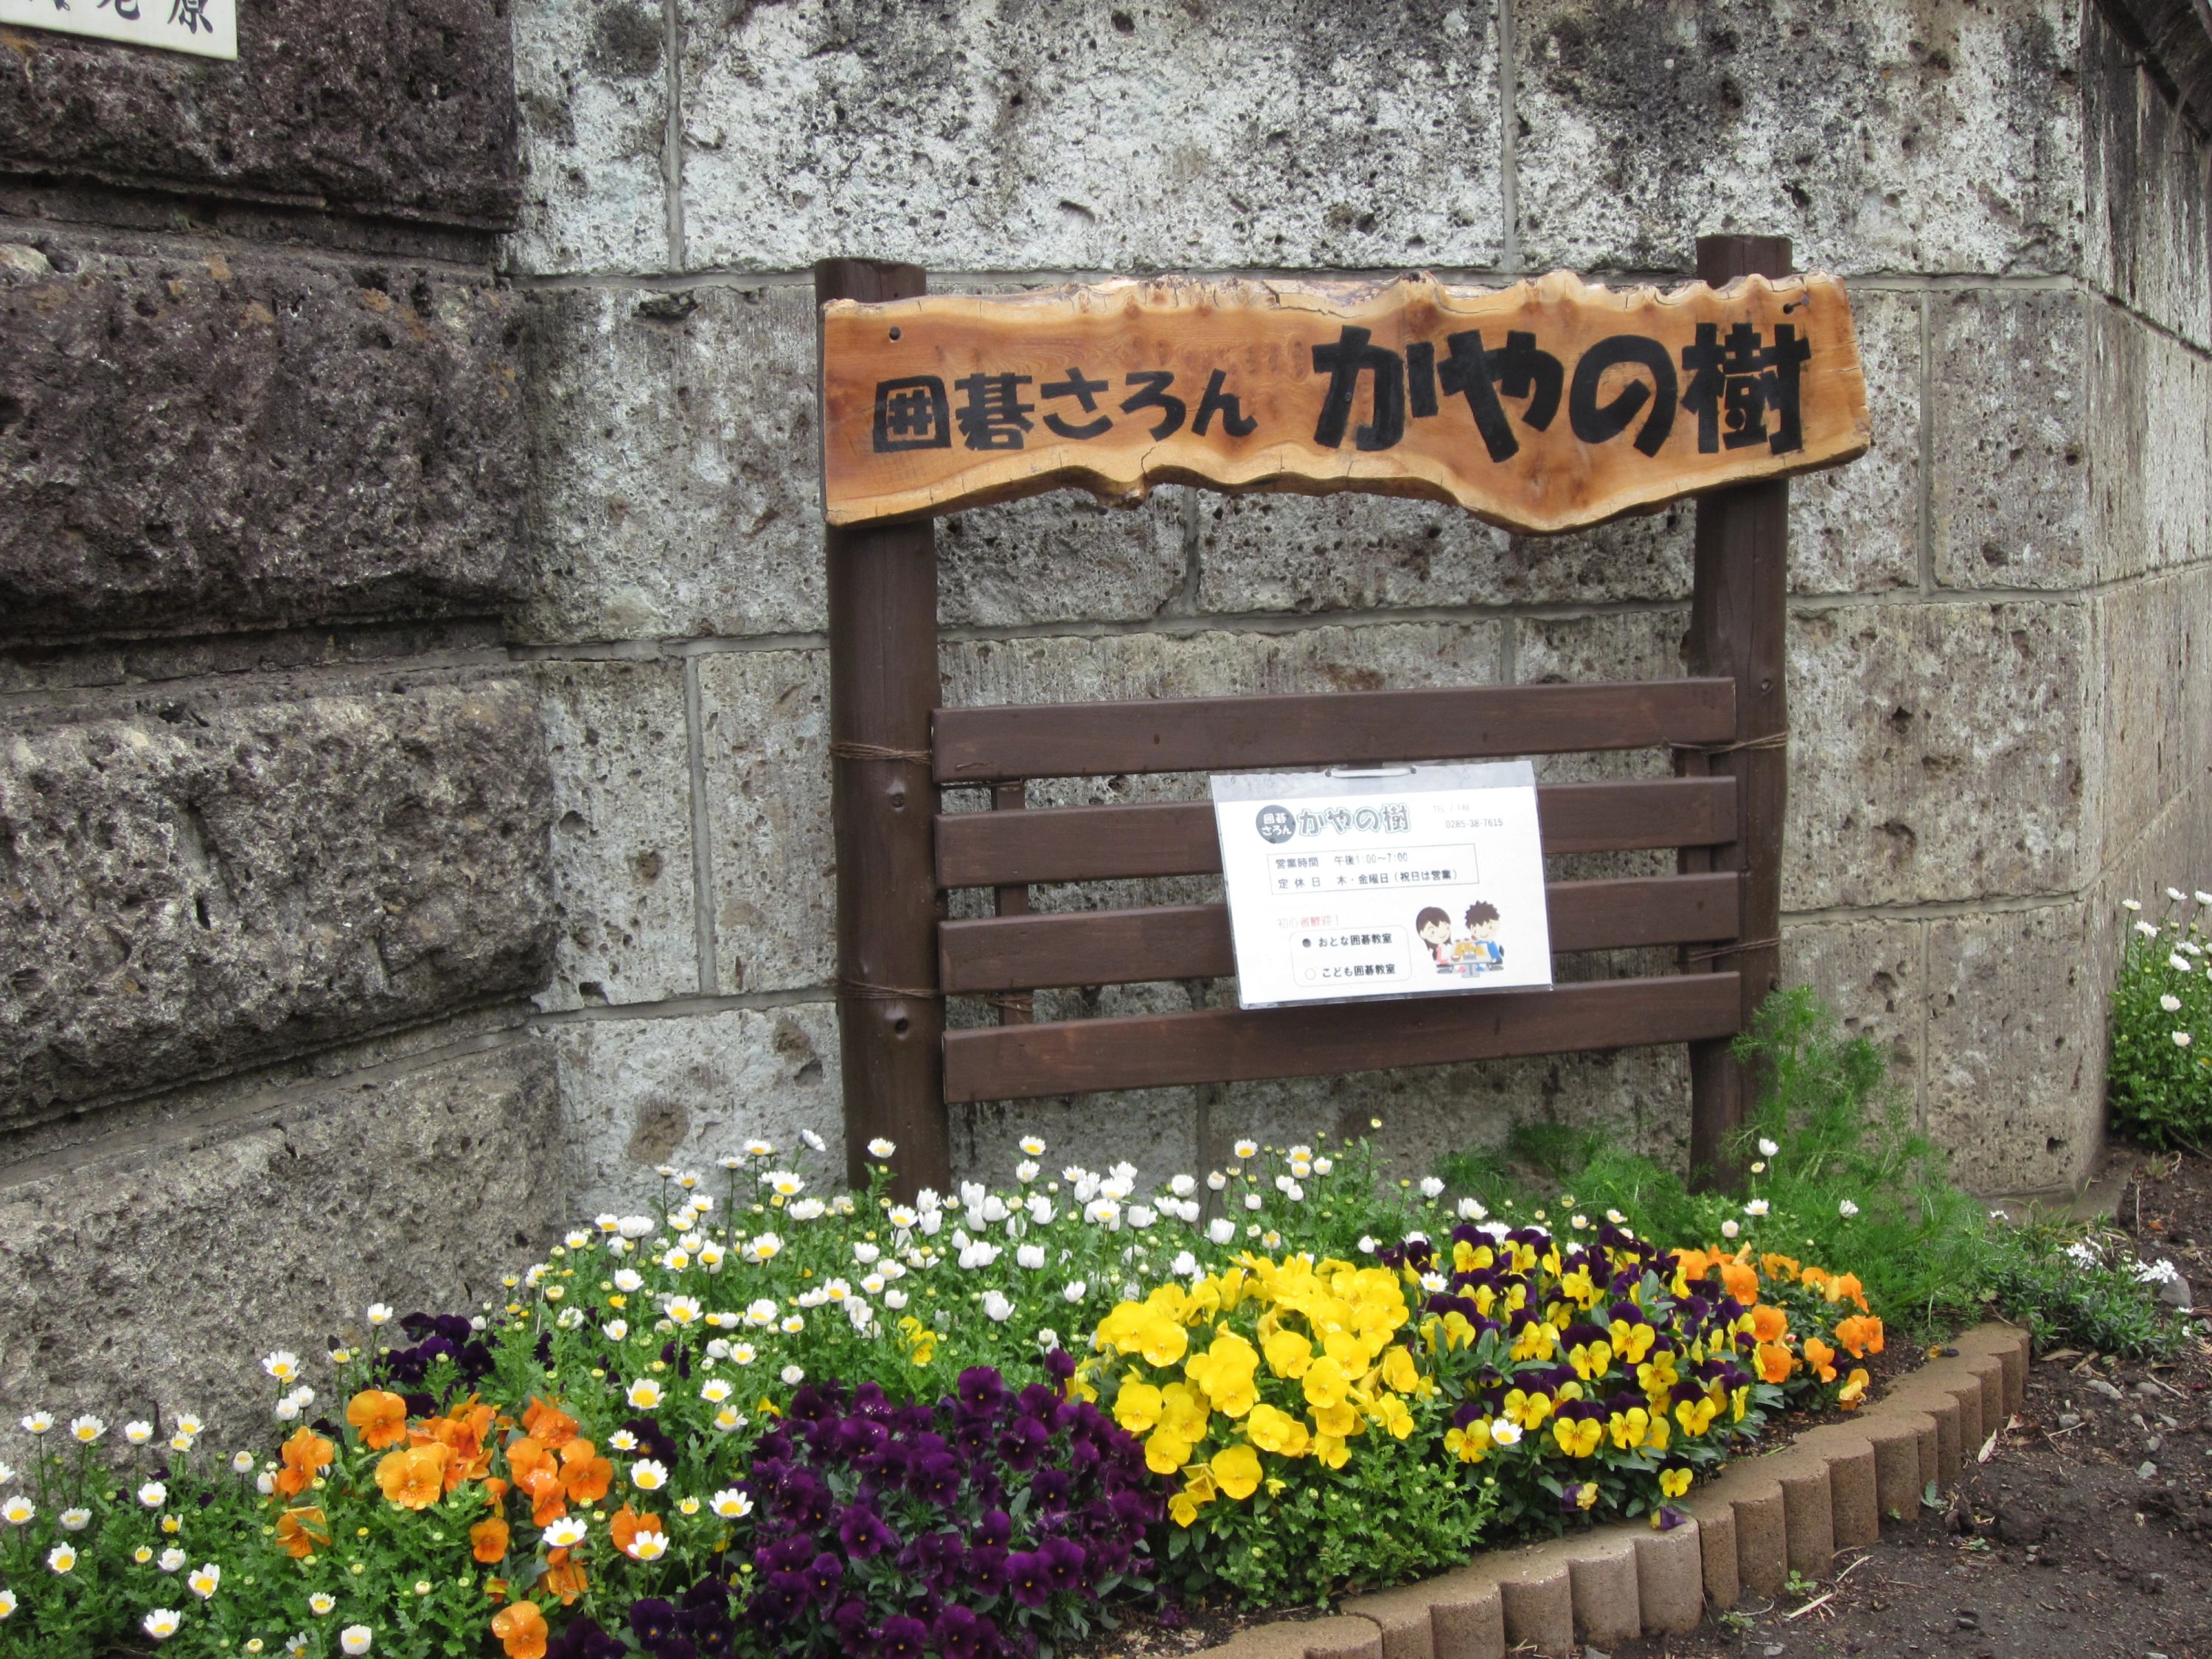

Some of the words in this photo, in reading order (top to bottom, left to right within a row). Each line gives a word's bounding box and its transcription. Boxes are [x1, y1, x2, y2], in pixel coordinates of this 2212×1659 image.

[873, 368, 1258, 452] 囲碁さろん
[1312, 322, 1812, 463] かやの樹
[1297, 804, 1411, 836] かやの樹
[1276, 857, 1319, 869] 営業時間
[1322, 964, 1397, 978] こども囲碁教室
